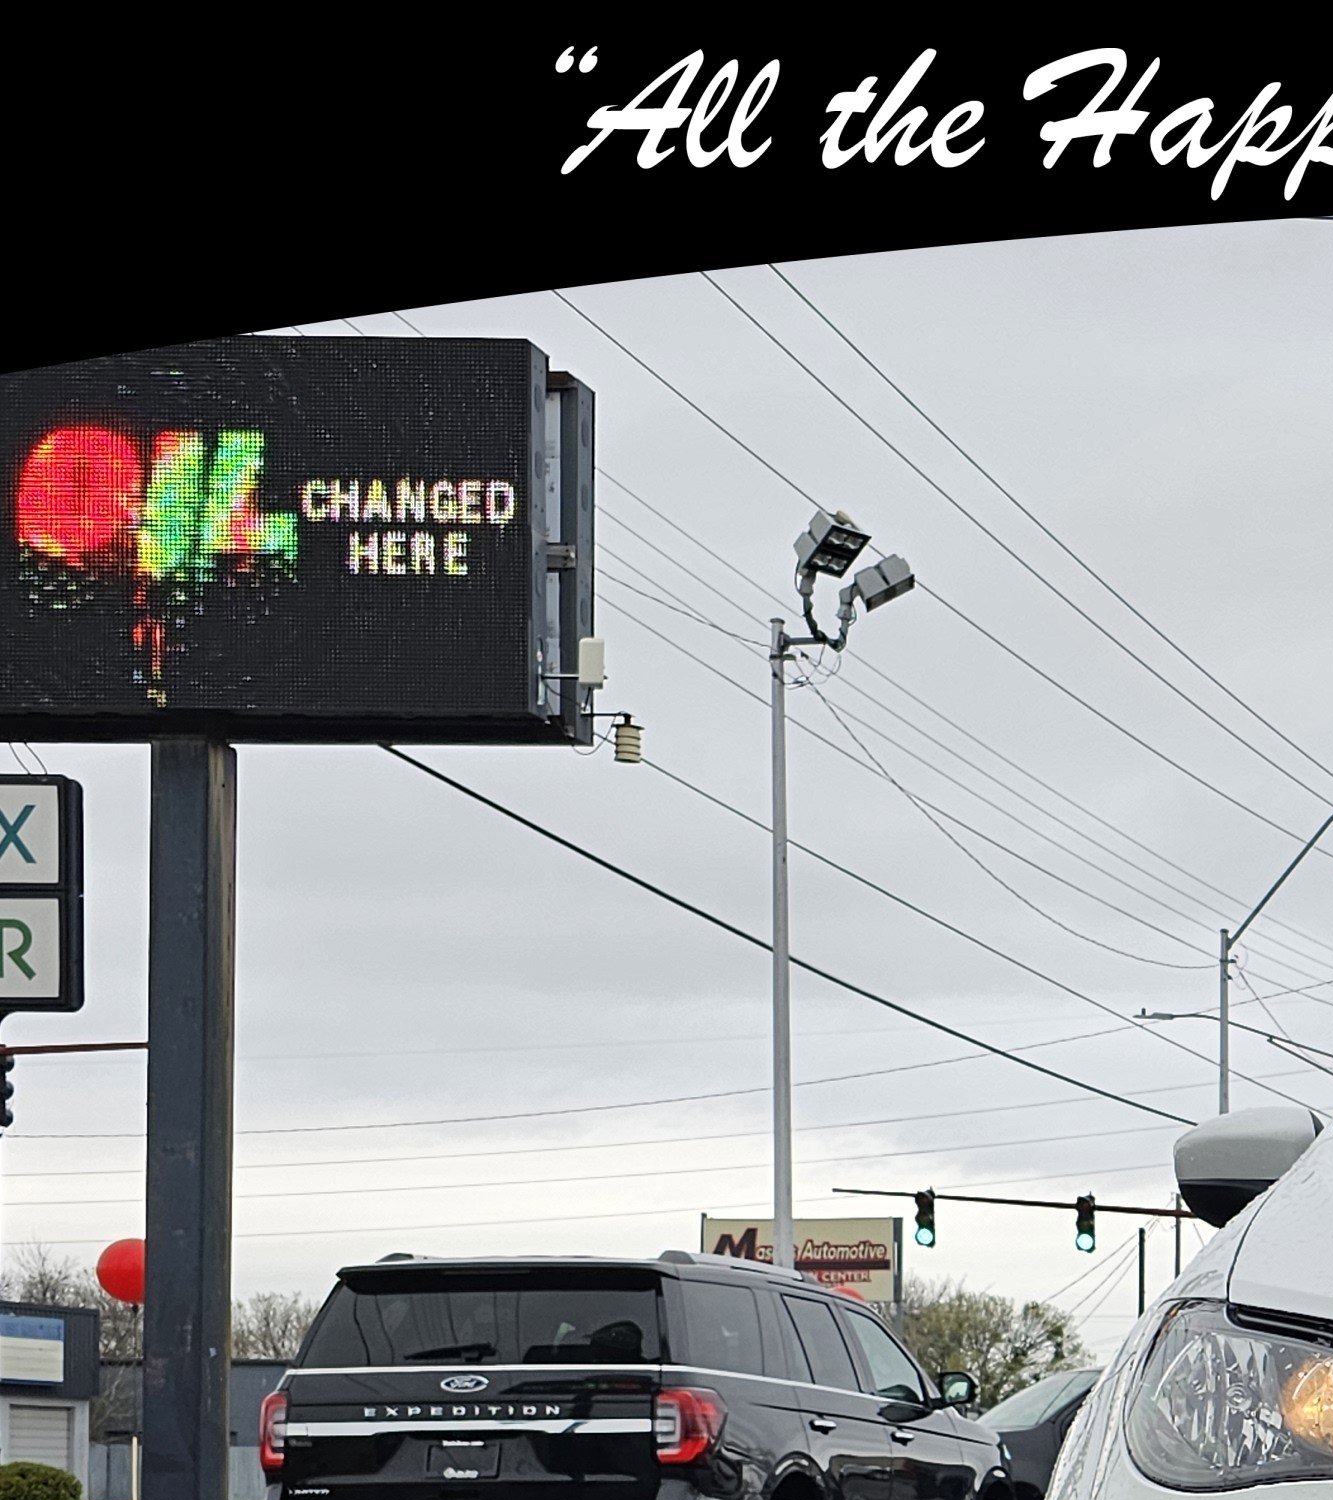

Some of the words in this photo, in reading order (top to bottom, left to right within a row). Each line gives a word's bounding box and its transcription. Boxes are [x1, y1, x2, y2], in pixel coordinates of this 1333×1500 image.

[301, 478, 515, 524] CHANGED
[349, 530, 469, 575] HERE
[803, 1240, 889, 1260] Automotive
[822, 1271, 870, 1283] CENTER
[364, 1405, 561, 1417] EXPEDITION
